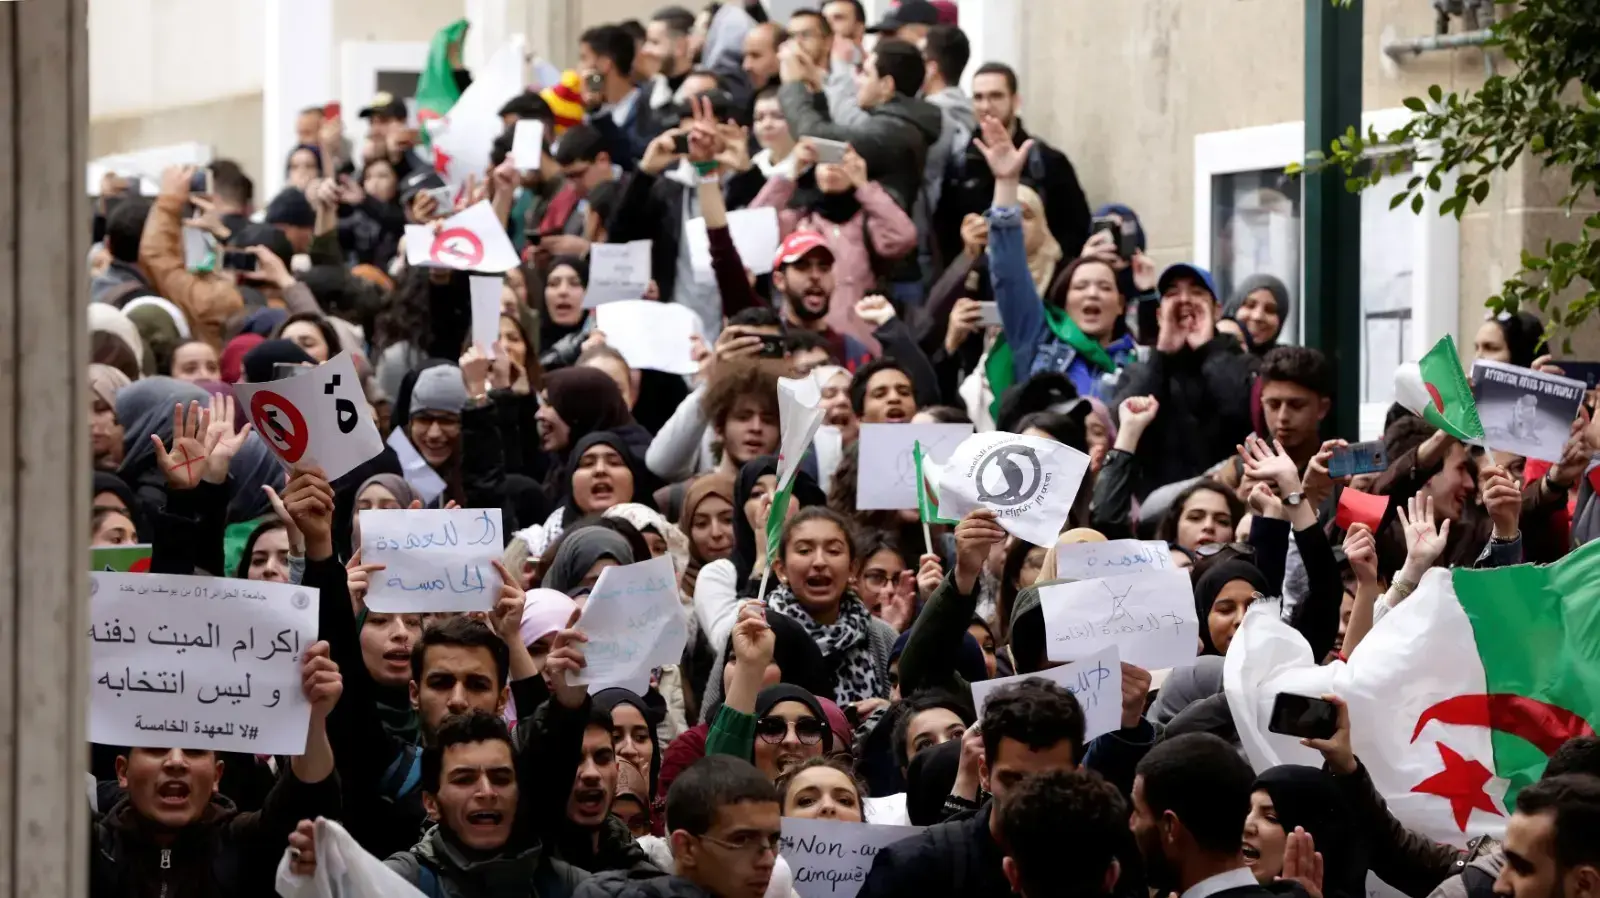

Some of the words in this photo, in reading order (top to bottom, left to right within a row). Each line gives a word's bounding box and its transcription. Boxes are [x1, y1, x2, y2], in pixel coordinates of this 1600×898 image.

[151, 584, 178, 598] يوسف
[242, 589, 268, 601] جامعة
[87, 617, 136, 644] دفنه
[147, 621, 220, 655] الميت
[232, 627, 300, 662] إكرام
[97, 666, 185, 698] انتخابه
[196, 672, 251, 706] ليس
[262, 687, 281, 708] و
[134, 714, 189, 733] الخامسة
[193, 719, 235, 739] للعهدة
[794, 866, 869, 893] cinquiè
